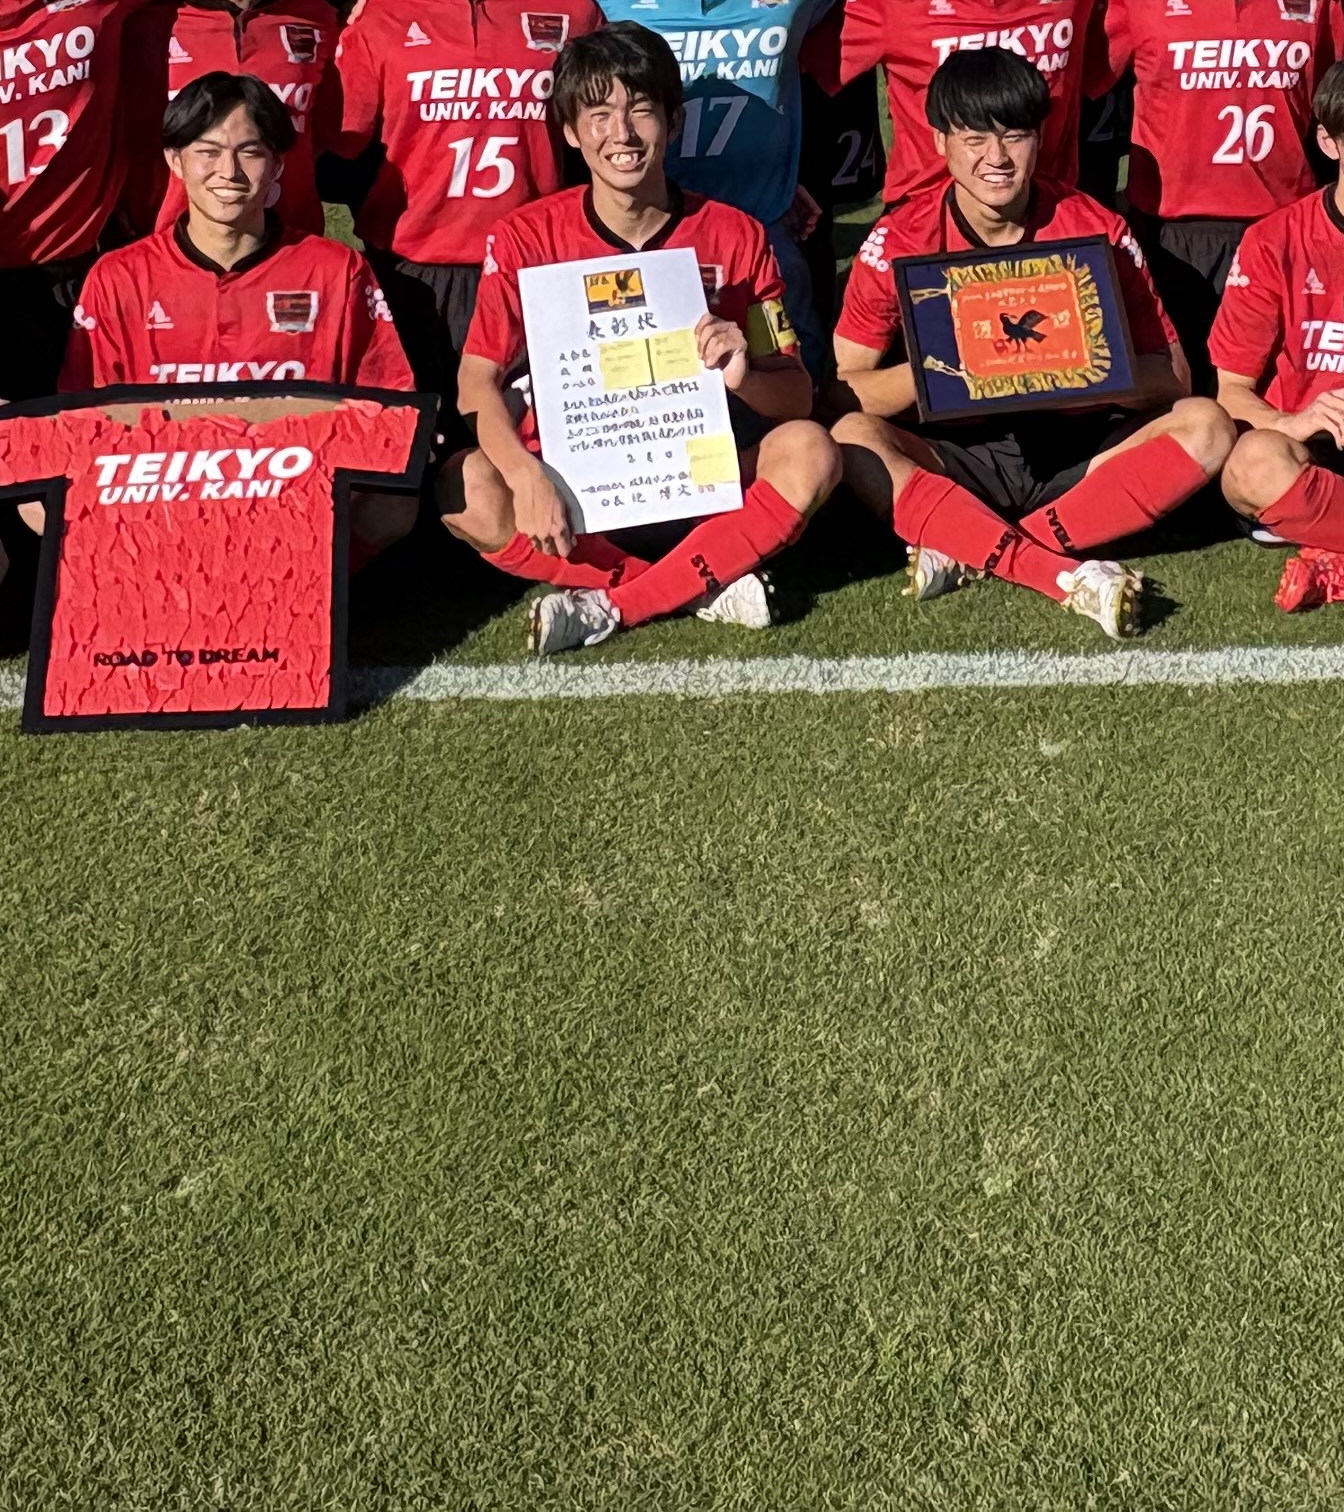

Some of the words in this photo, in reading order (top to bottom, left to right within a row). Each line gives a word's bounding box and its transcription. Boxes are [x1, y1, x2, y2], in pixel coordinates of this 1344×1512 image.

[662, 26, 788, 61] EIKYO
[1167, 39, 1311, 71] TEIKYO
[28, 59, 90, 95] KANI
[717, 59, 779, 81] KANI
[1027, 50, 1070, 72] ANI
[406, 68, 553, 102] TEIKYO
[1179, 72, 1241, 90] UNIV.
[1247, 70, 1300, 89] KANI
[419, 100, 483, 121] UNIV.
[488, 99, 546, 121] KANI
[680, 96, 749, 157] 17
[1211, 105, 1276, 164] 26
[446, 136, 519, 198] 15
[95, 447, 313, 487] TEIKYO
[99, 484, 190, 505] UNIV.
[200, 480, 283, 501] KANI
[94, 650, 158, 667] ROAD
[164, 650, 194, 667] TO
[199, 647, 279, 665] DREAM
